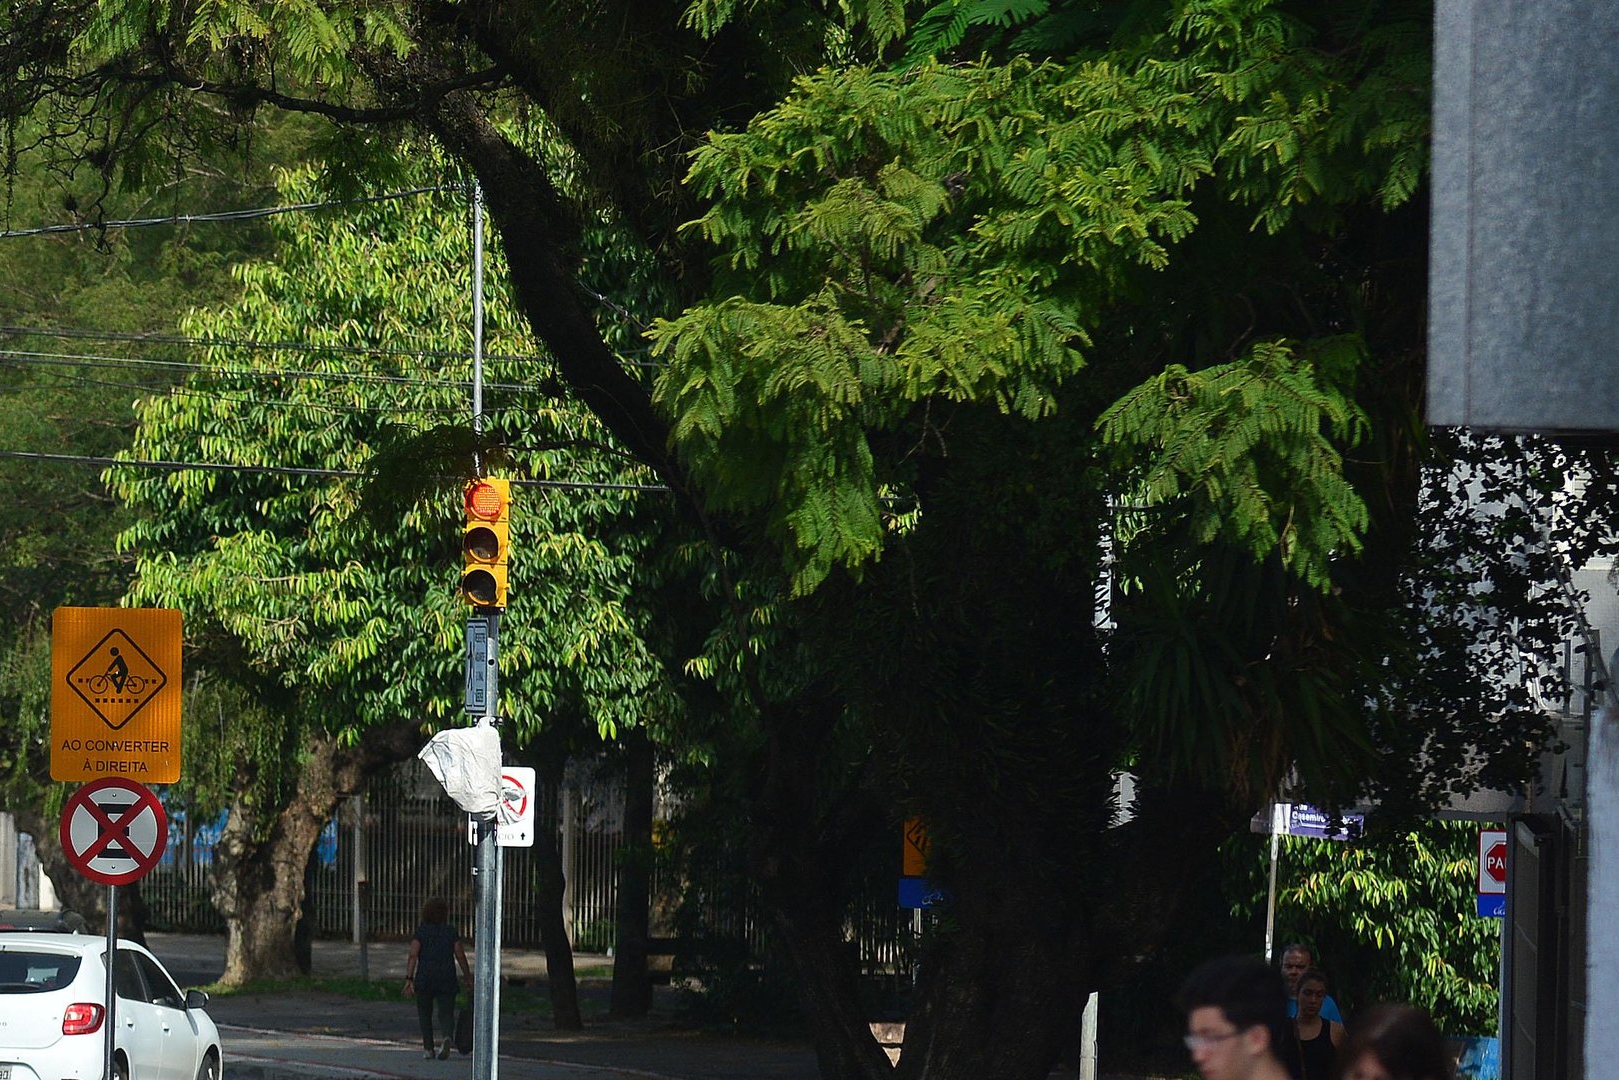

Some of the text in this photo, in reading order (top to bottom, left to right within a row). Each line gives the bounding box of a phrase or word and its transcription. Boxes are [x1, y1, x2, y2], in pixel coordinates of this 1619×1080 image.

[62, 740, 170, 753] AO CONVERTER
[83, 758, 149, 773] À DIREITA
[1487, 856, 1507, 870] PA
